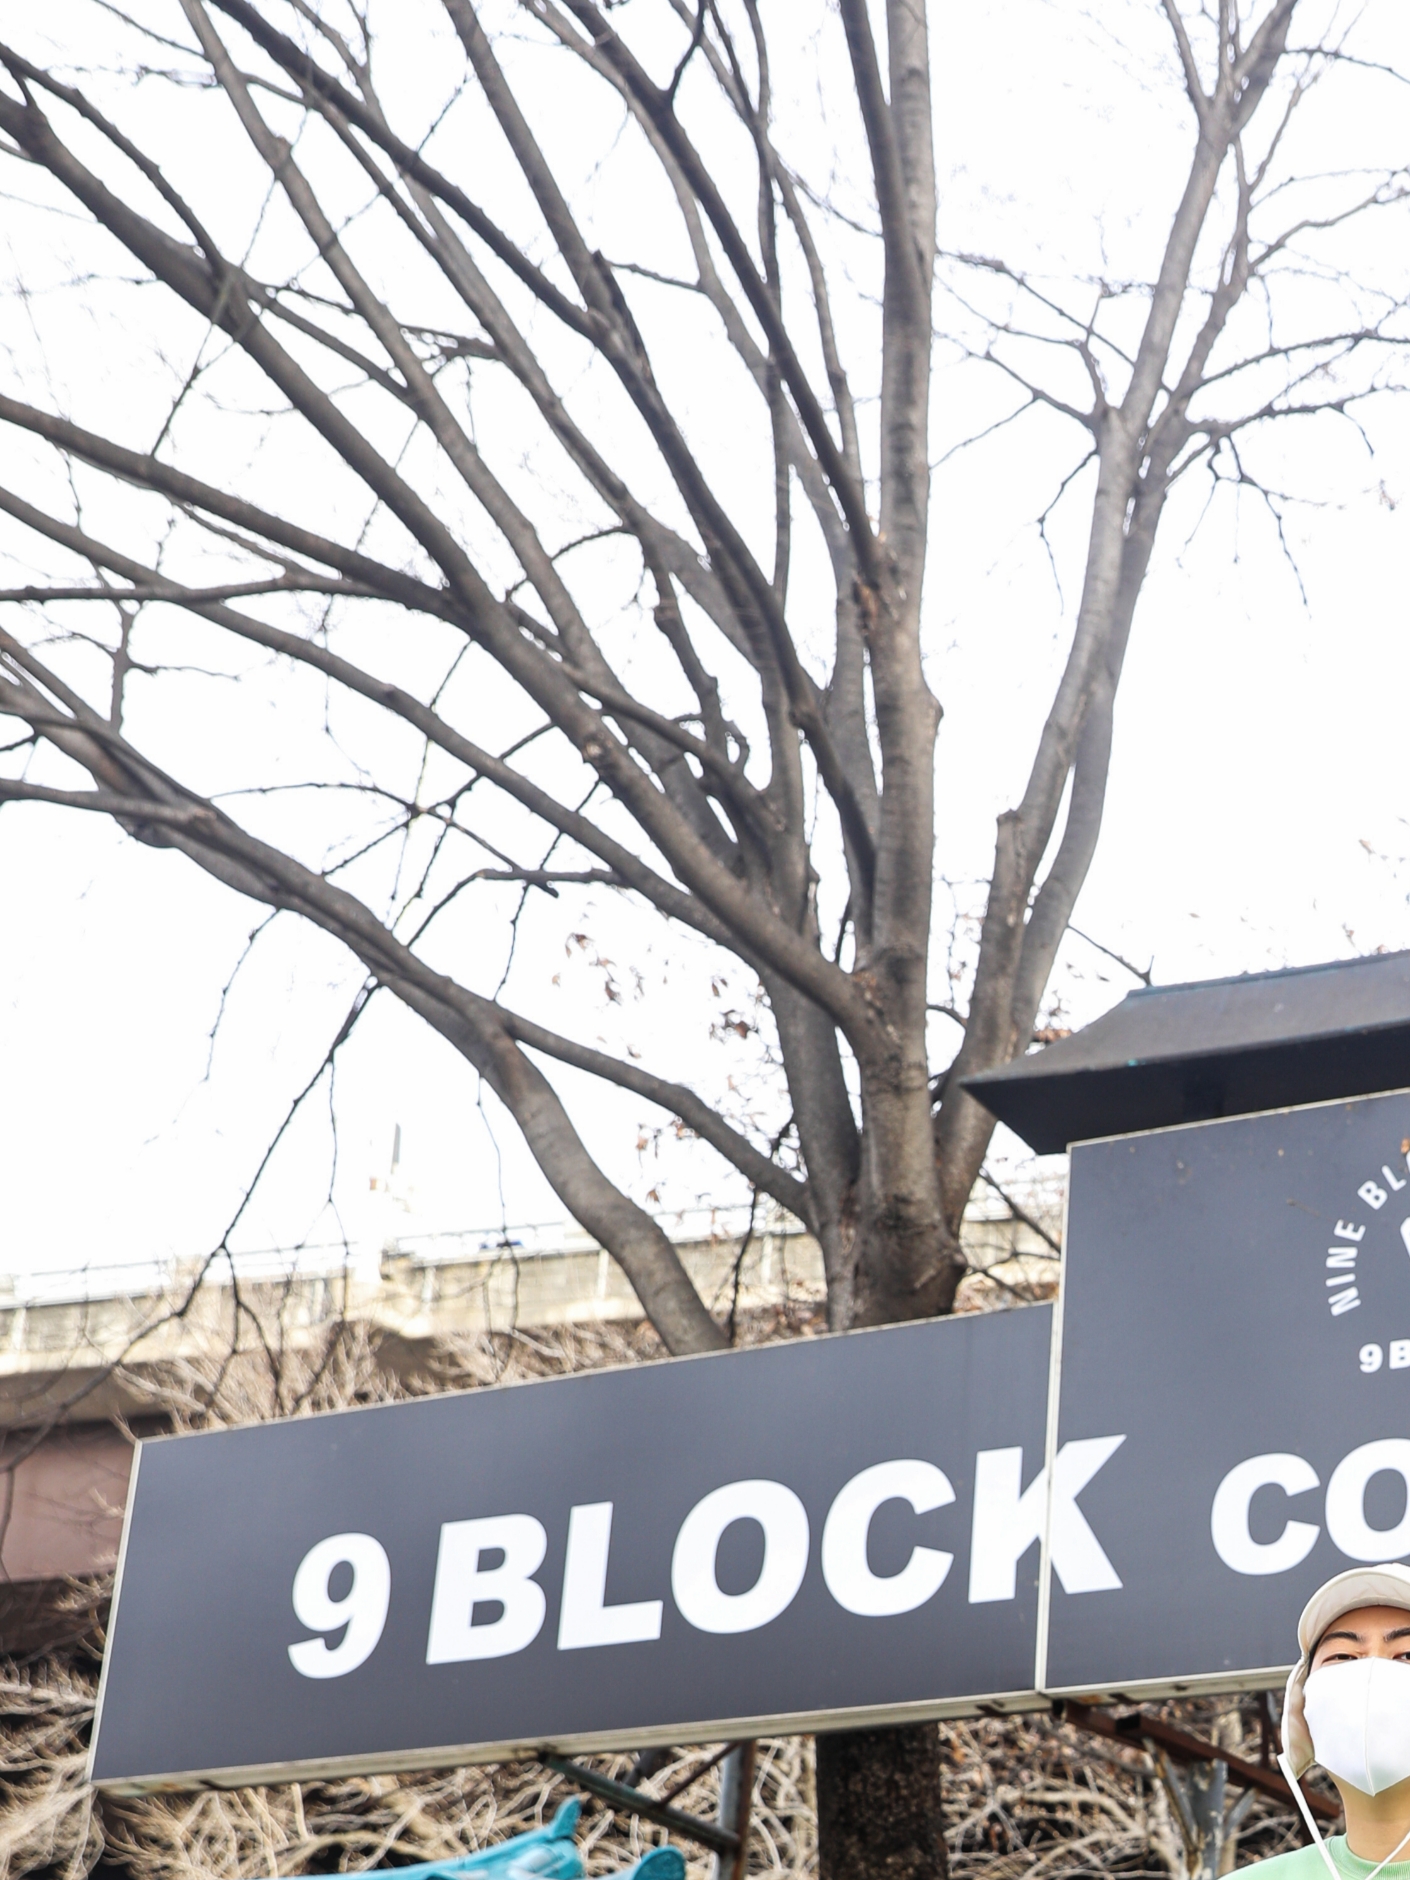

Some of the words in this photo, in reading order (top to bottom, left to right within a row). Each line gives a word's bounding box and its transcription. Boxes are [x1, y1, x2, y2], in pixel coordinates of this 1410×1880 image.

[1325, 1218, 1367, 1317] NINE
[1359, 1343, 1384, 1374] 9
[287, 1532, 392, 1680] 9
[425, 1434, 1128, 1666] BLOCK
